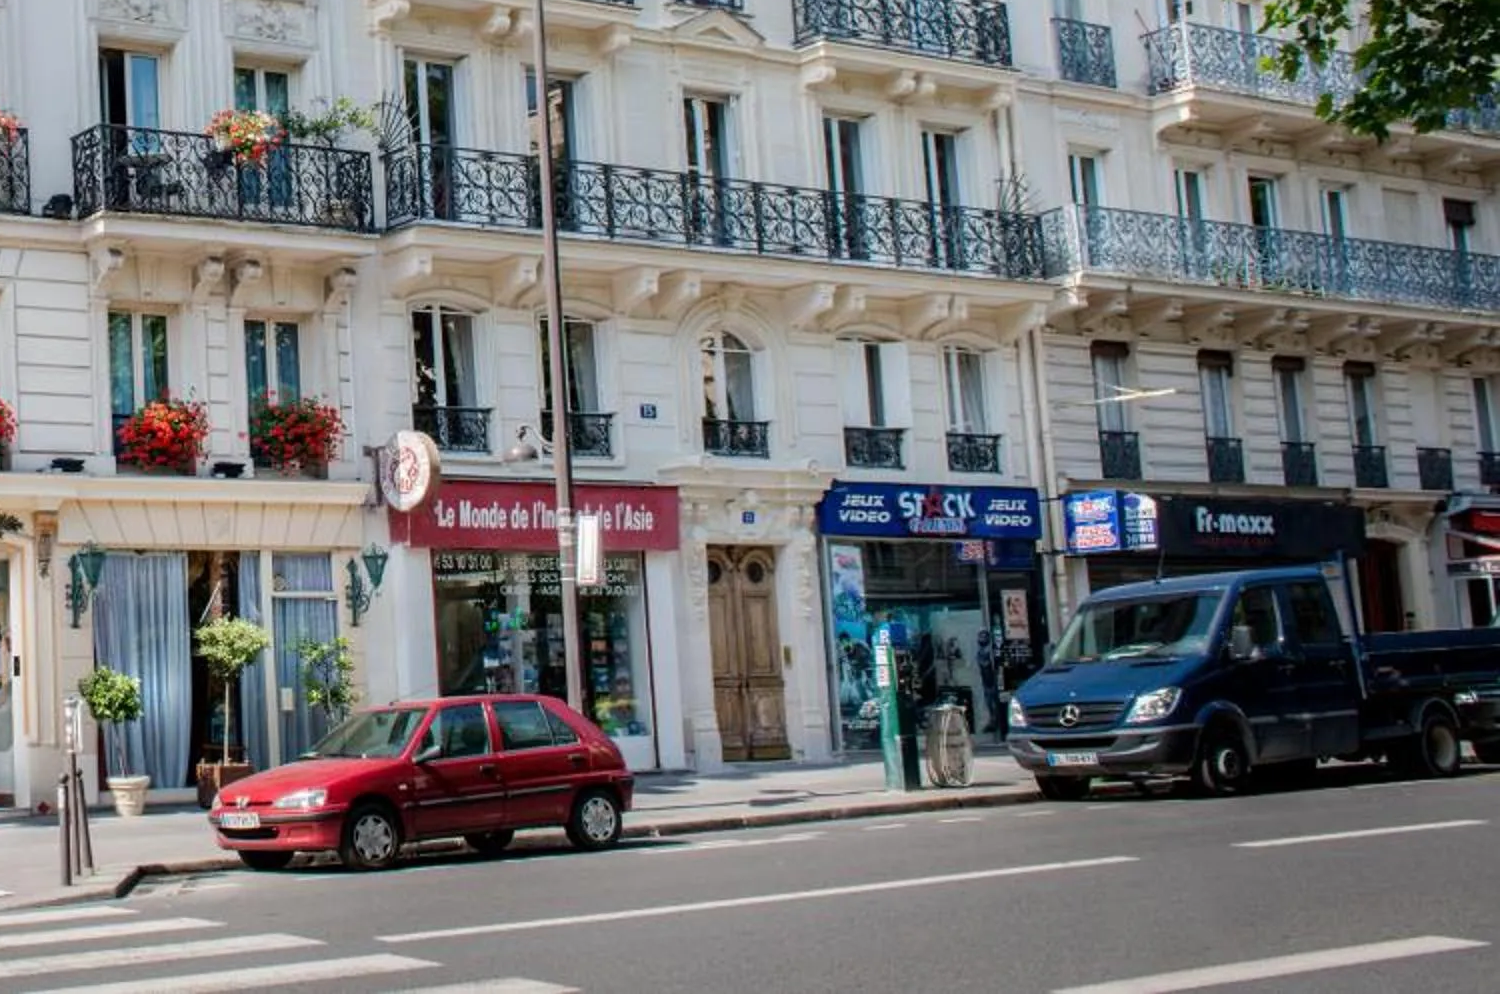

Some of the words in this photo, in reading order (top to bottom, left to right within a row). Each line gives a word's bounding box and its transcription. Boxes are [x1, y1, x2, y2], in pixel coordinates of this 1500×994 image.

[841, 494, 885, 507] JEUX
[988, 499, 1028, 511] JEUX
[436, 500, 455, 527] Le
[459, 499, 507, 529] Monde
[510, 501, 529, 529] de
[615, 502, 654, 531] l'Asie
